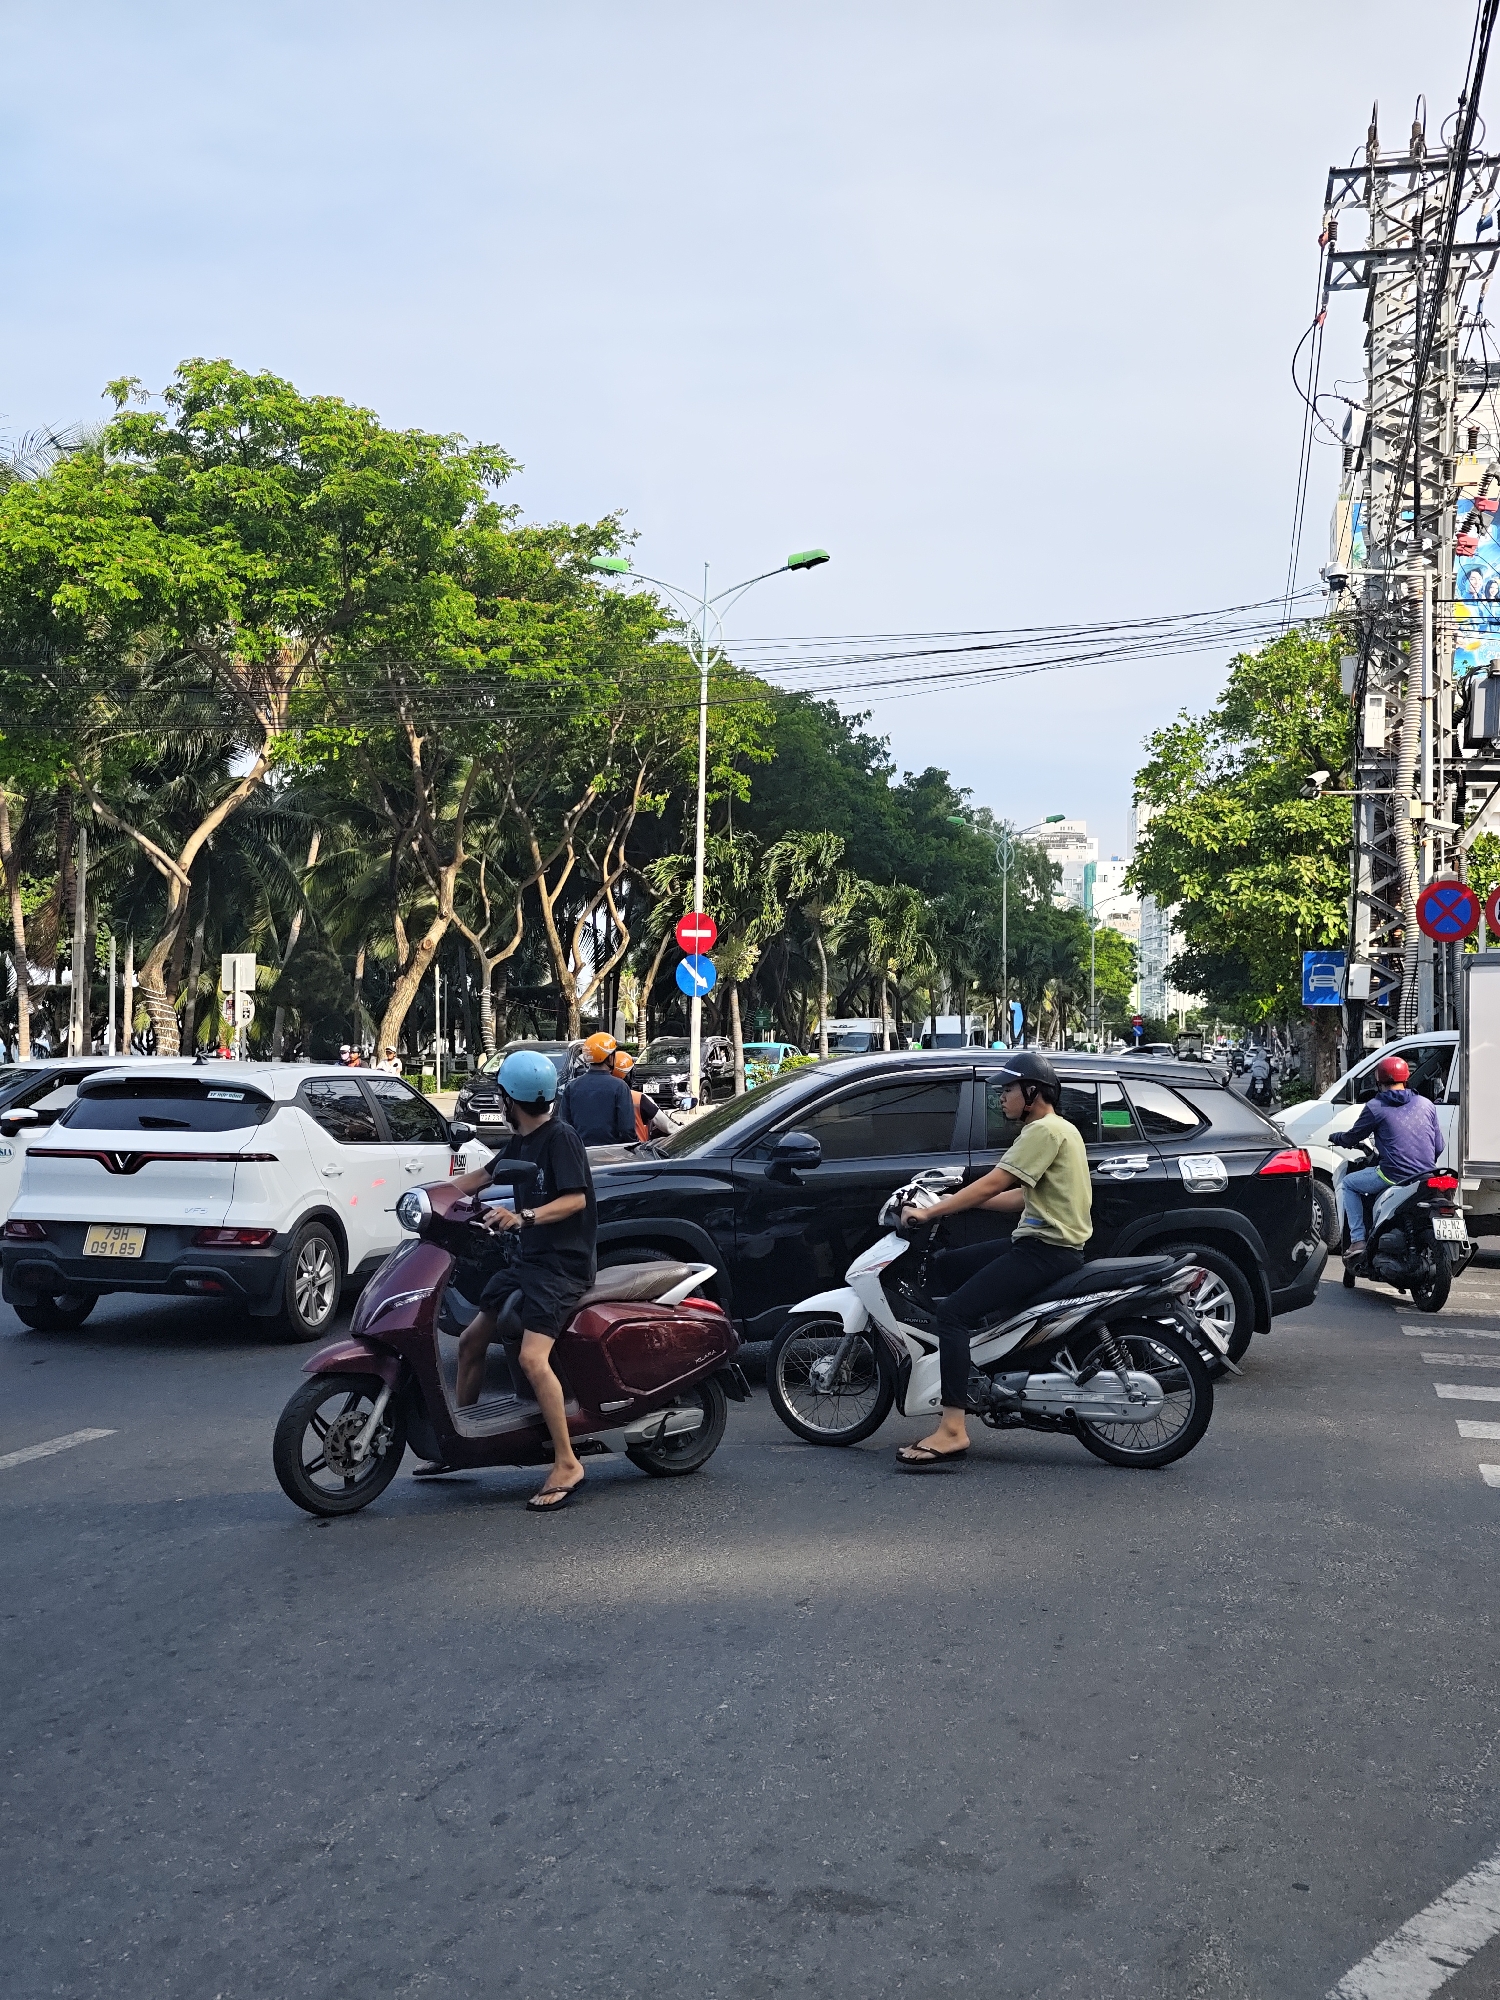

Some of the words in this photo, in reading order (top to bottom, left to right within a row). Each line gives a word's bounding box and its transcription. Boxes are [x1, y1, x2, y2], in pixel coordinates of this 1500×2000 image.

[105, 1227, 129, 1241] 79H
[90, 1240, 137, 1256] 091.85
[695, 1349, 717, 1364] KLARA
